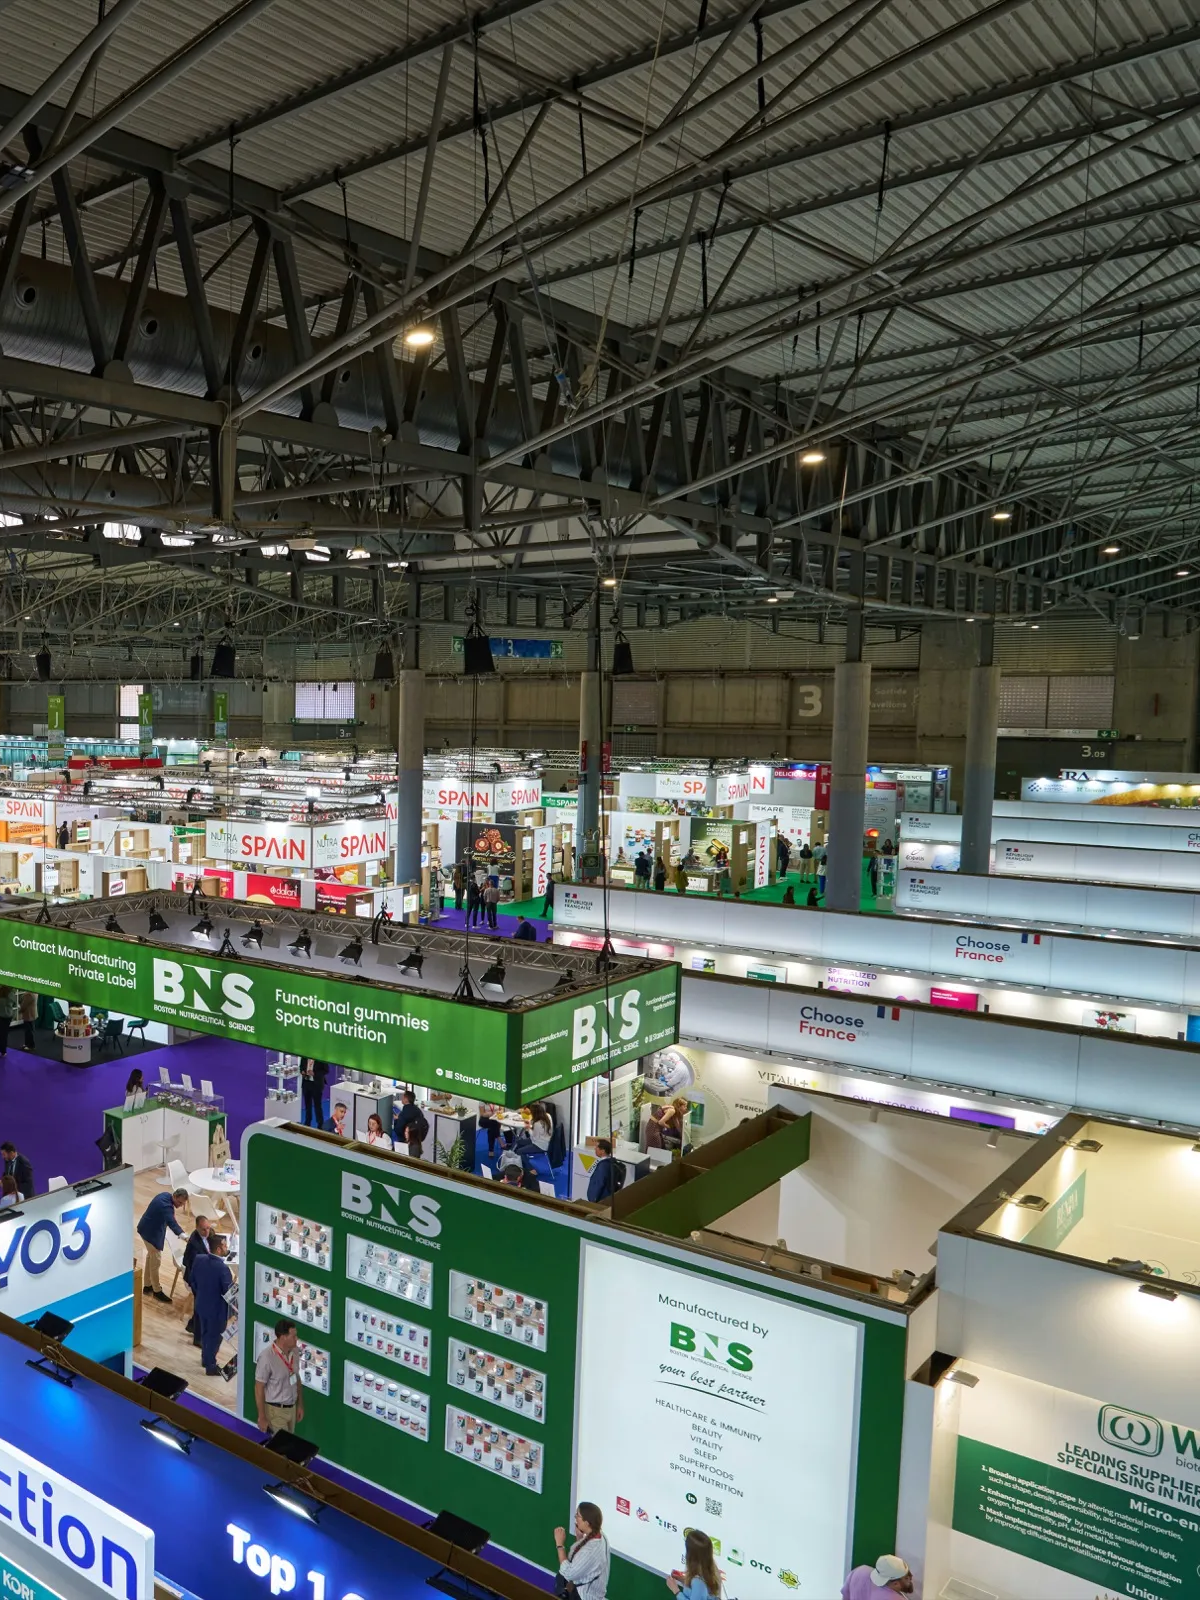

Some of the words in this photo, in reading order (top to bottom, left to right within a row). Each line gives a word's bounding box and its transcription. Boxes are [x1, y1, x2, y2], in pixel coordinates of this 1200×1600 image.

[798, 685, 822, 717] 3
[53, 711, 59, 729] J
[142, 708, 149, 724] K
[219, 709, 224, 721] L
[1081, 745, 1106, 758] 3.09
[659, 779, 681, 787] NUTRA
[728, 783, 749, 800] SPAIN
[6, 800, 43, 818] SPAIN
[438, 790, 489, 807] SPAIN
[511, 788, 539, 805] SPAIN
[210, 831, 238, 842] NUTRA
[241, 834, 305, 861] SPAIN
[316, 836, 338, 848] NUTRA
[340, 831, 386, 858] SPAIN
[538, 843, 547, 894] SPAIN
[757, 836, 766, 885] SPAIN
[276, 884, 298, 897] dallant
[13, 935, 56, 955] Contract
[58, 945, 136, 976] Manufacturing
[955, 935, 1011, 952] Choose
[955, 948, 1004, 963] France
[68, 964, 105, 983] Private
[107, 974, 137, 990] Label
[153, 957, 256, 1021] BNS
[827, 976, 871, 988] NUTRITION
[153, 1004, 177, 1016] BOSTON
[179, 1010, 226, 1028] NUTRACEUTICAL
[228, 1020, 256, 1034] SCIENCE
[275, 988, 350, 1016] Functional
[354, 1005, 430, 1032] gummies
[800, 1006, 865, 1028] Choose
[275, 1008, 320, 1029] Sports
[323, 1020, 387, 1044] nutrition
[572, 989, 641, 1061] BNS
[652, 1031, 665, 1042] Stand
[799, 1020, 857, 1042] France
[521, 1051, 536, 1060] Private
[535, 1045, 548, 1055] Label
[522, 1039, 540, 1051] Contract
[539, 1029, 569, 1044] Manufacturing
[571, 1060, 589, 1074] BOSTON
[590, 1049, 623, 1068] NUTRACEUTICAL
[623, 1039, 640, 1052] SCIENCE
[454, 1072, 481, 1086] Stand
[482, 1078, 507, 1093] 3B136
[734, 1103, 764, 1113] FRENCH
[341, 1170, 442, 1238] BNS
[341, 1211, 364, 1224] BOSTON
[366, 1219, 413, 1241] NUTRACEUTICAL
[415, 1235, 442, 1251] SCIENCE
[658, 1293, 749, 1330] Manufactured
[752, 1322, 769, 1339] by
[670, 1321, 754, 1372] BNS
[669, 1348, 689, 1359] BOSTON
[690, 1355, 729, 1373] NUTRACEUTICAL
[731, 1369, 753, 1381] SCIENCE
[659, 1362, 686, 1378] your
[690, 1370, 716, 1388] best
[717, 1383, 766, 1407] partner
[655, 1397, 708, 1423] HEALTHCARE
[710, 1418, 717, 1426] &
[719, 1421, 762, 1443] IMMUNITY
[691, 1423, 723, 1440] BEAUTY
[689, 1434, 724, 1452] VITALITY
[694, 1447, 718, 1462] SLEEP
[679, 1453, 734, 1481] SUPERFOODS
[1065, 1442, 1127, 1472] LEADING
[669, 1462, 696, 1478] SPORT
[698, 1473, 744, 1498] NUTRITION
[1057, 1451, 1156, 1494] SPECIALISING
[988, 1466, 1017, 1482] Broaden
[1017, 1477, 1056, 1496] application
[1055, 1490, 1077, 1503] scope
[1087, 1500, 1114, 1517] altering
[1114, 1512, 1144, 1527] material
[1144, 1522, 1184, 1541] properties,
[988, 1475, 1004, 1485] such
[1102, 1515, 1117, 1525] and
[1117, 1521, 1140, 1534] odour.
[663, 1520, 678, 1533] IFS
[987, 1487, 1016, 1503] Enhance
[1016, 1498, 1044, 1514] product
[1044, 1507, 1072, 1523] stability
[1083, 1520, 1114, 1540] reducing
[1114, 1534, 1150, 1552] sensitivity
[986, 1506, 1004, 1519] Mask
[1004, 1513, 1043, 1532] unpleasant
[1042, 1528, 1067, 1541] odours
[1067, 1537, 1081, 1547] and
[1081, 1541, 1107, 1556] reduce
[1107, 1550, 1136, 1566] flavour
[1135, 1561, 1182, 1584] degradation
[1084, 1531, 1104, 1542] metal
[226, 1522, 297, 1596] Top
[994, 1516, 1027, 1535] improving
[1026, 1529, 1054, 1544] diffusion
[1068, 1544, 1111, 1566] volatilisation
[1119, 1564, 1136, 1574] core
[1135, 1568, 1172, 1588] materials.
[750, 1559, 772, 1575] OTC
